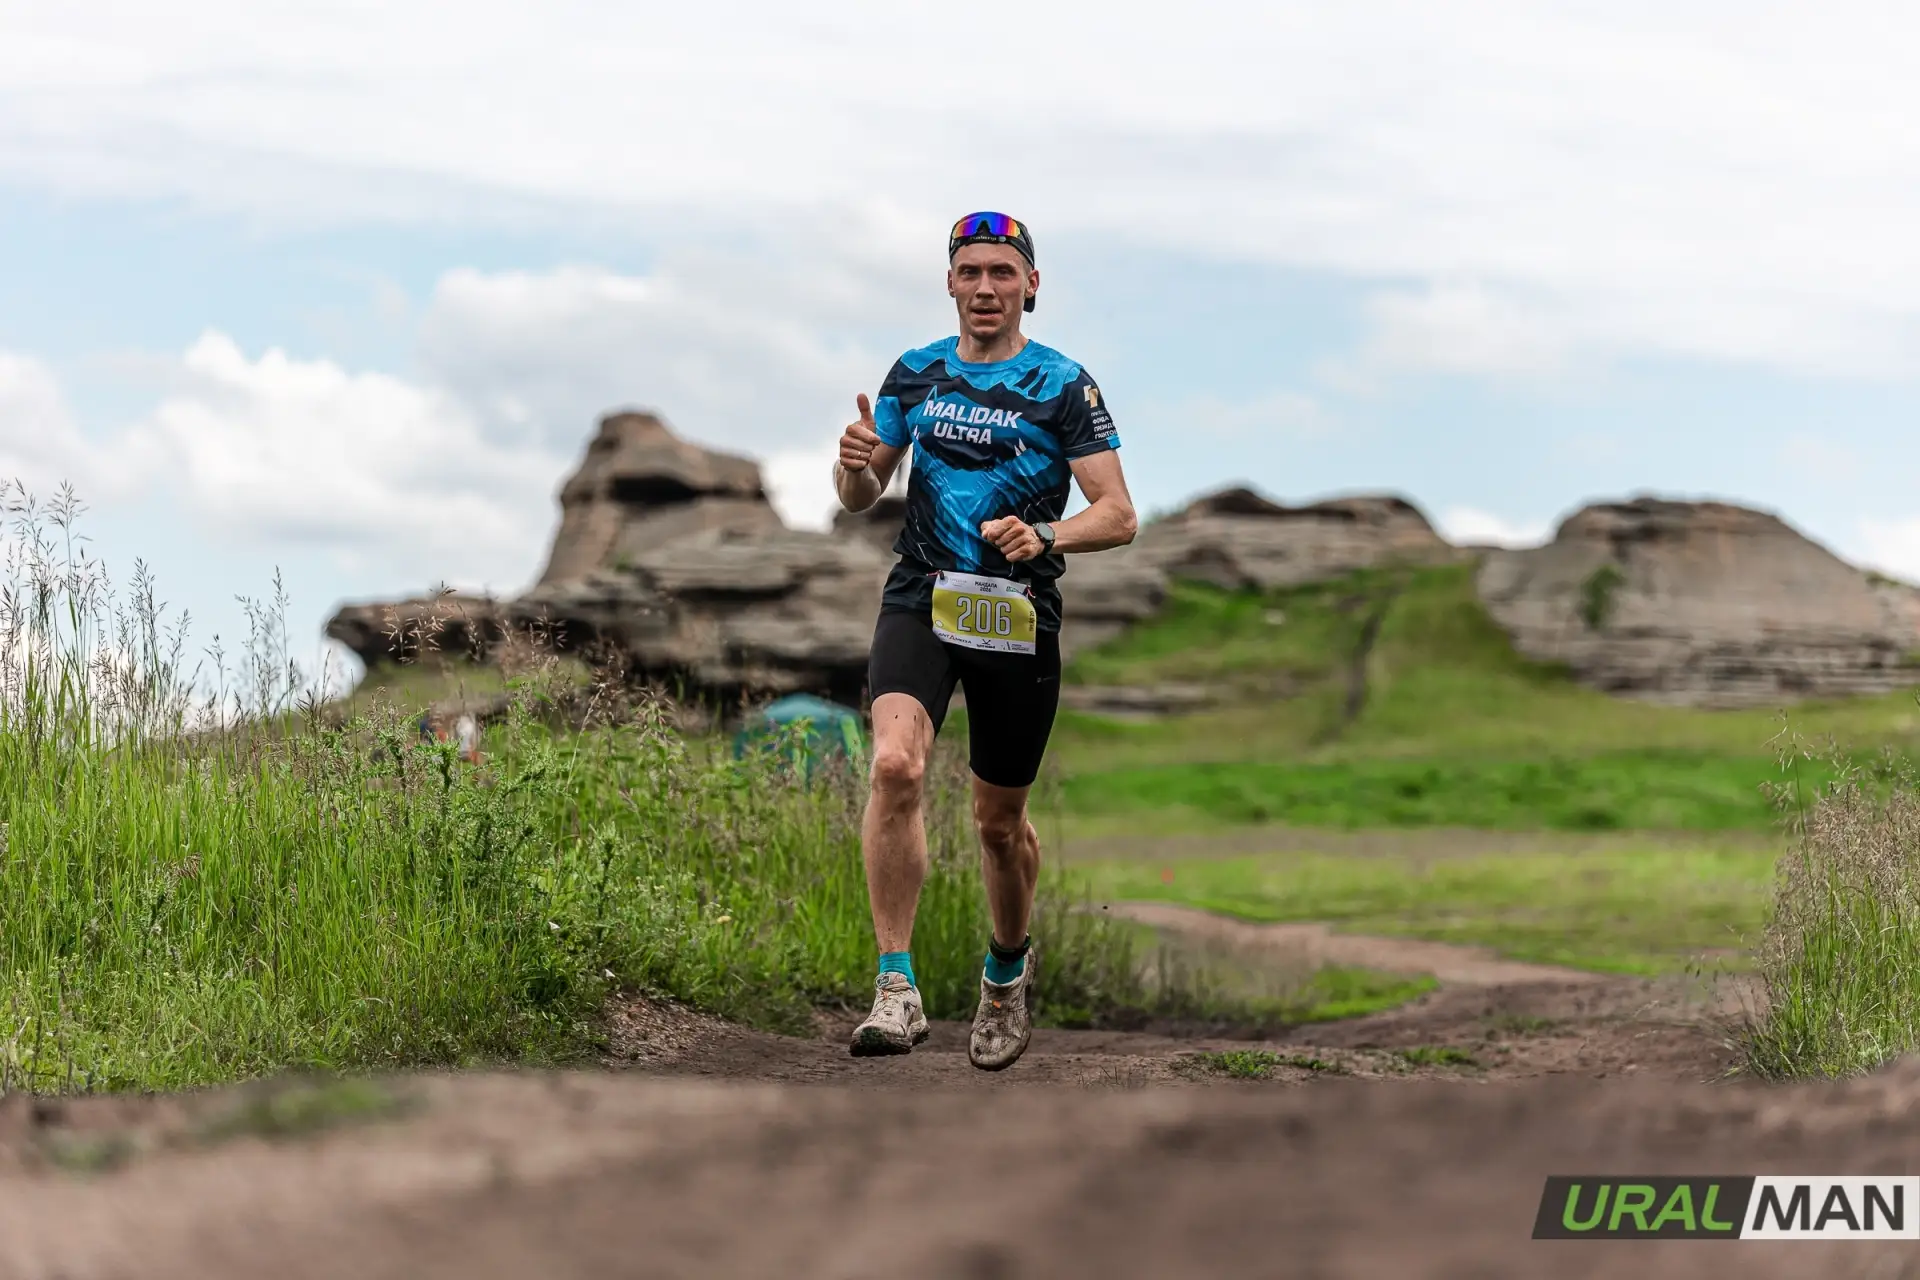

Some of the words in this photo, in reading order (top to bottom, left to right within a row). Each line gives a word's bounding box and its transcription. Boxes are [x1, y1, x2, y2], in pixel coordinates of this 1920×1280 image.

[922, 400, 1023, 429] MALIDAK
[933, 421, 992, 445] ULTRA
[956, 596, 1012, 636] 206
